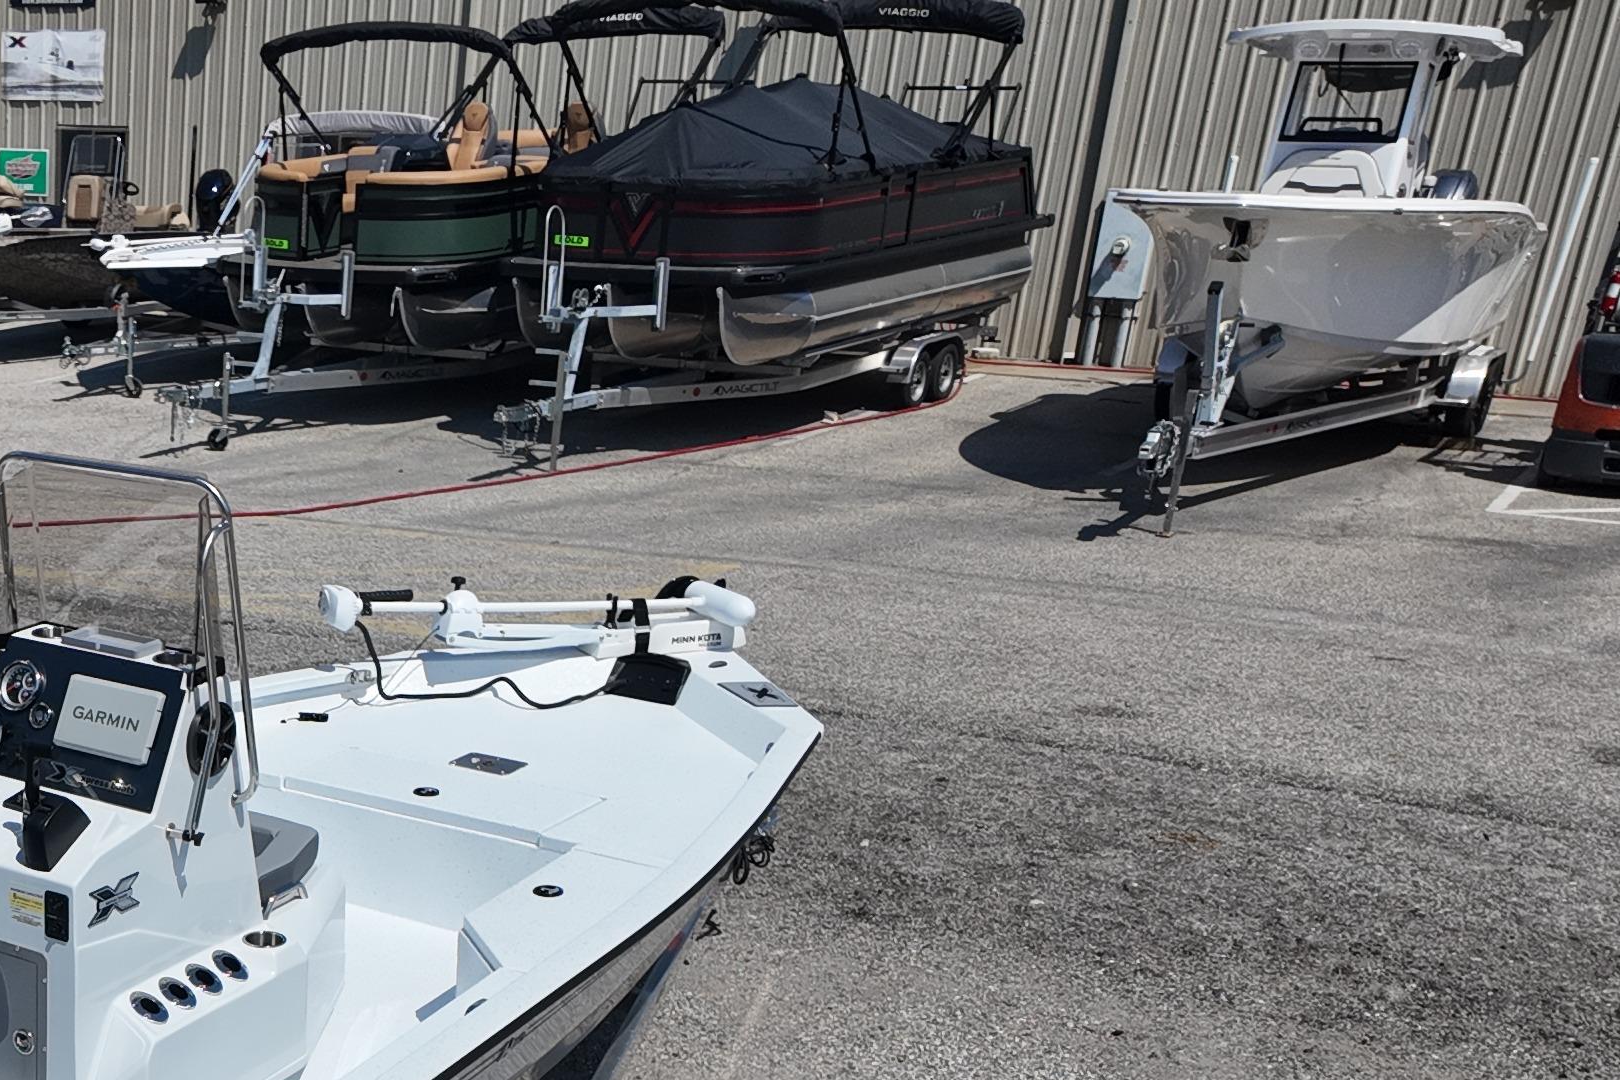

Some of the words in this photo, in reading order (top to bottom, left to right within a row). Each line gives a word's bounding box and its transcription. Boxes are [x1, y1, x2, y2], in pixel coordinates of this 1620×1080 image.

[879, 8, 930, 17] VIAGGIO
[671, 636, 695, 645] MINN
[697, 633, 722, 642] KOTA
[72, 705, 140, 732] GARMIN
